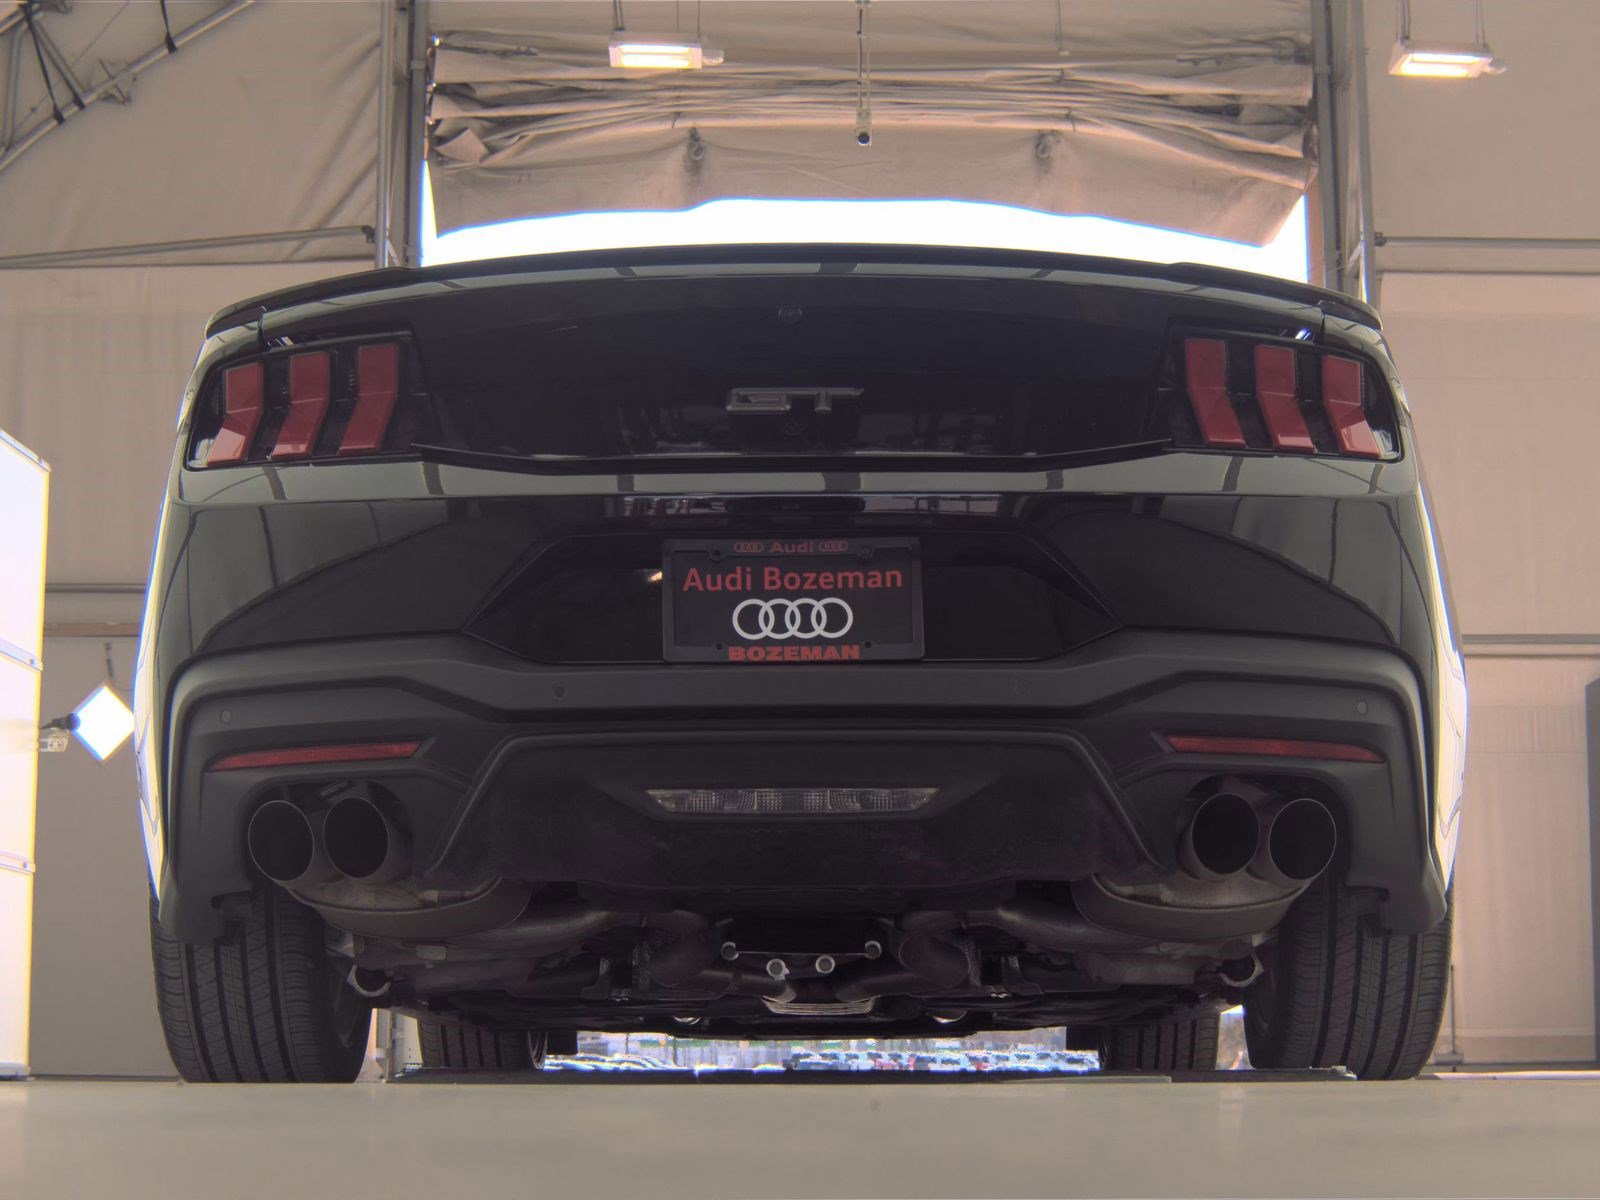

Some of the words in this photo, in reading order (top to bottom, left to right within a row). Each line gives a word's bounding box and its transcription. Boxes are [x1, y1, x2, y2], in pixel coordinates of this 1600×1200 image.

[726, 387, 864, 413] GT
[769, 542, 814, 553] Audi
[682, 566, 752, 591] Audi
[763, 566, 903, 590] Bozeman
[728, 645, 861, 661] BOZEMAN
